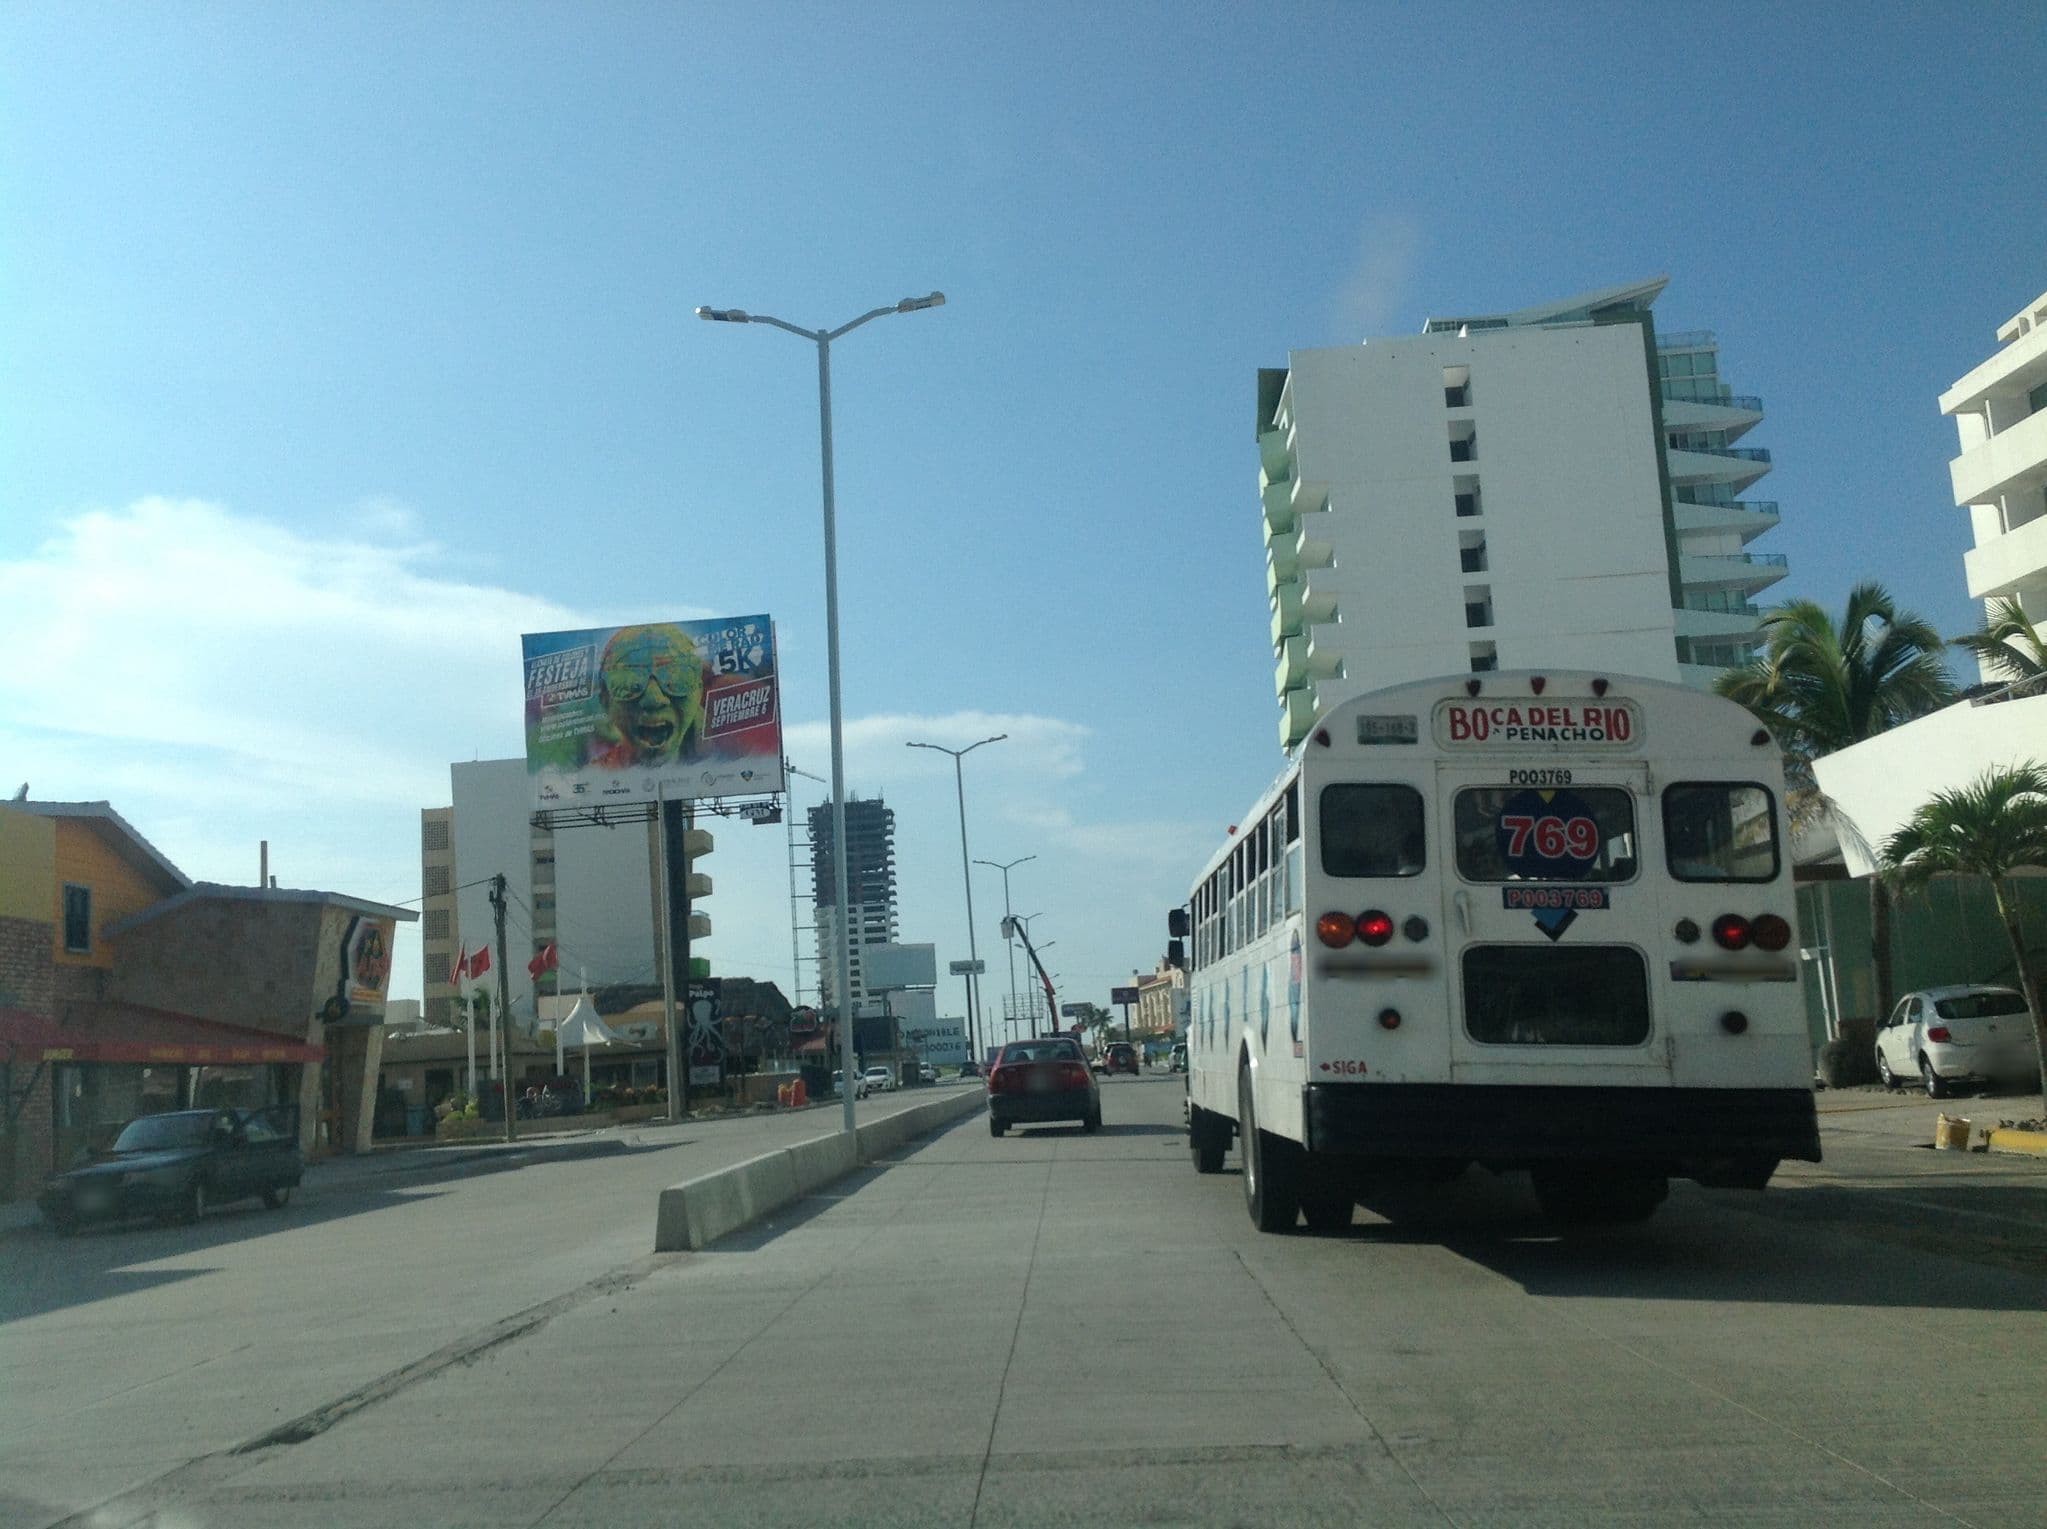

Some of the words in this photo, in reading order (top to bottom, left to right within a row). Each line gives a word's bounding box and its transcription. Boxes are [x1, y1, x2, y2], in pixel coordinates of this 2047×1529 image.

[527, 656, 588, 689] FESTEJA
[718, 648, 758, 675] 5K
[712, 685, 771, 716] VERACRUZ
[710, 706, 760, 729] SEPTIEMBRE
[761, 702, 767, 715] 6
[1448, 706, 1524, 741] BOCA
[1528, 707, 1577, 727] DEL
[1583, 707, 1630, 741] RIO
[1506, 728, 1605, 741] PENACHO
[1509, 769, 1572, 785] P003769
[1501, 815, 1599, 859] 769
[1507, 888, 1603, 908] P003769
[1332, 1060, 1368, 1074] SIGA
